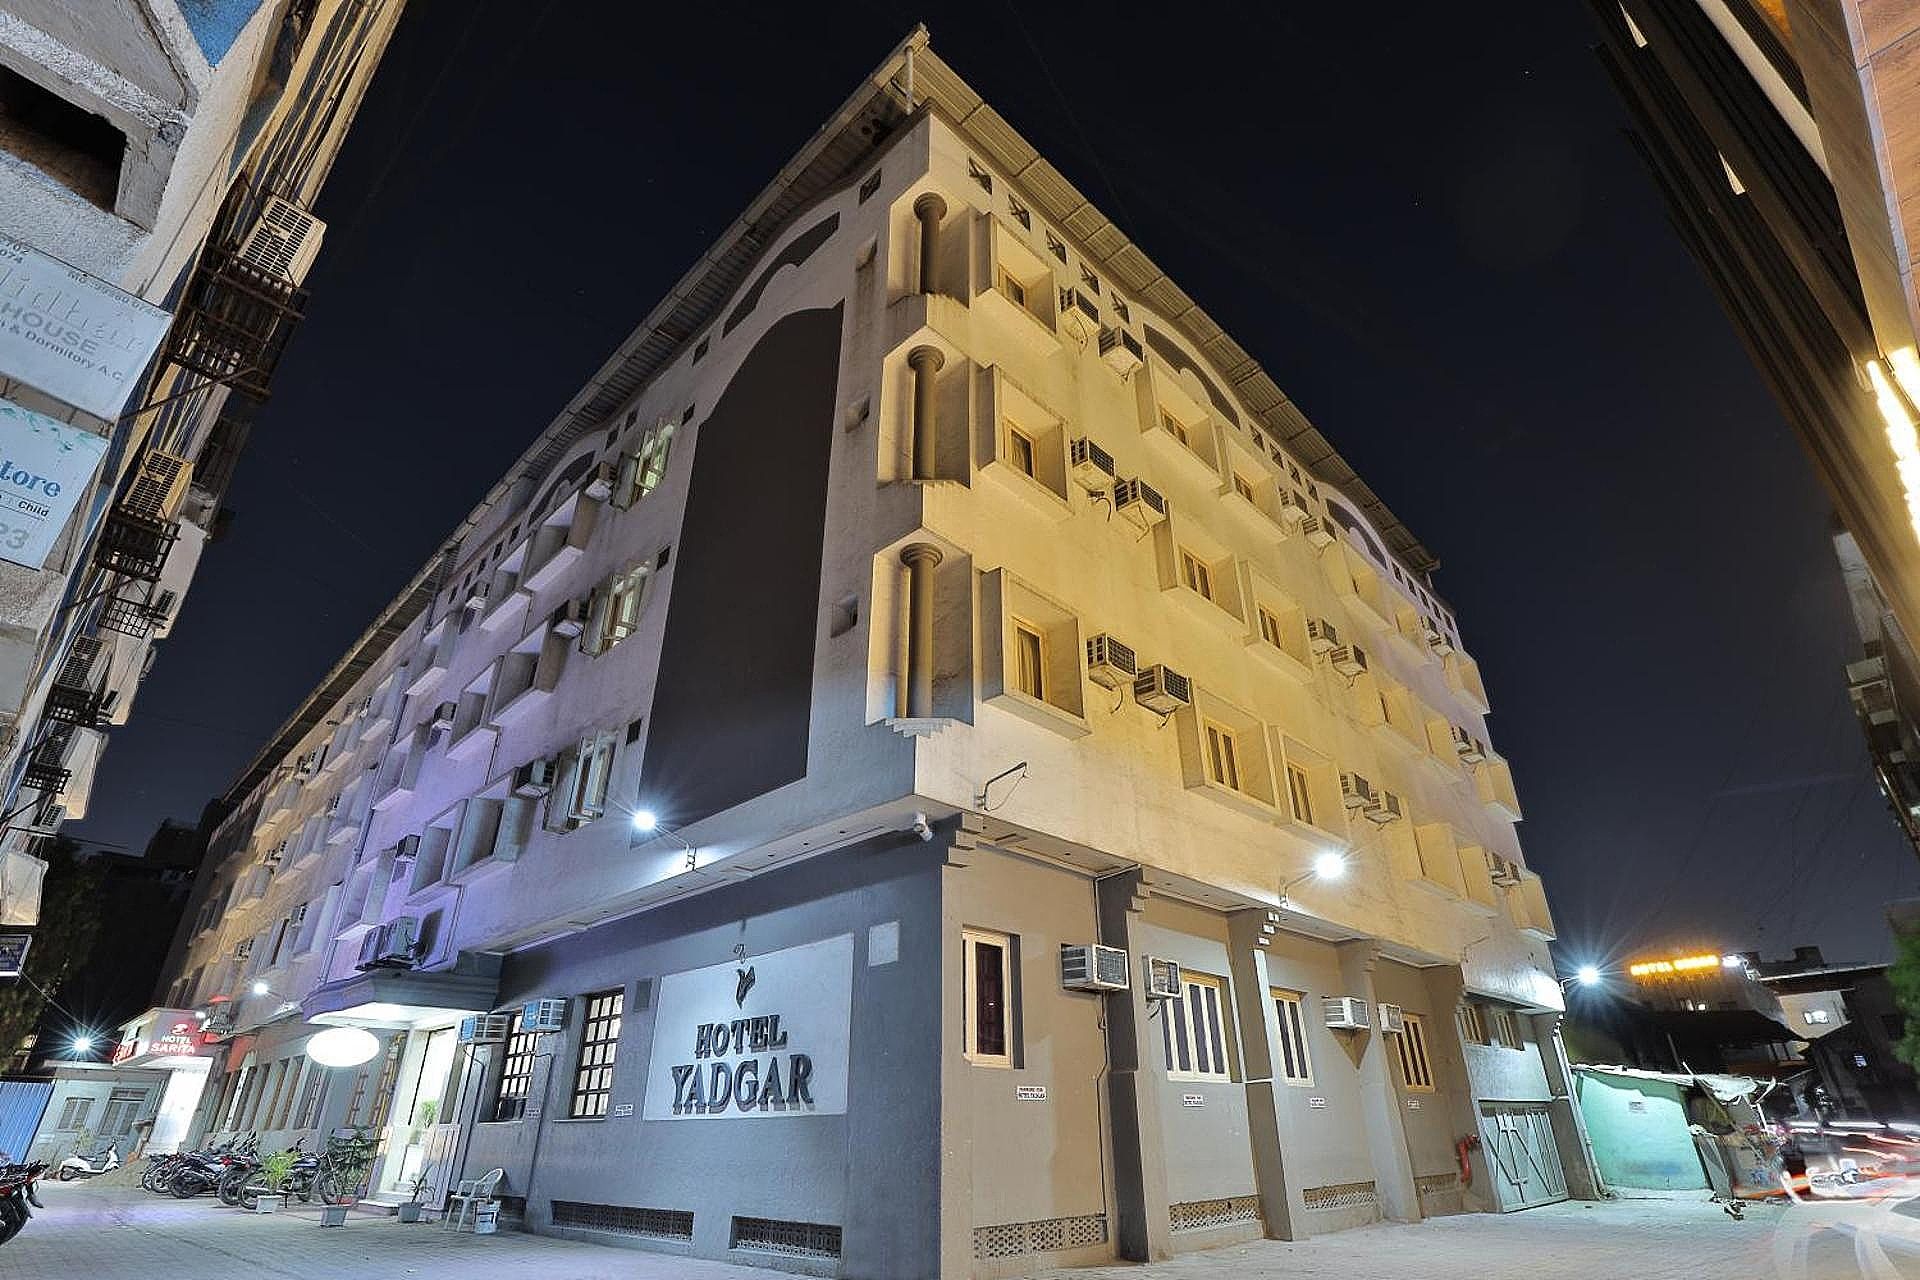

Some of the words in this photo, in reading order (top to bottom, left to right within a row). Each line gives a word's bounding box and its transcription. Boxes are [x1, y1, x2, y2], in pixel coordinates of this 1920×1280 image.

[0, 302, 100, 354] HOUSE
[25, 330, 96, 368] Dormitory
[18, 500, 49, 517] Child
[151, 1043, 195, 1054] SARITA
[161, 1034, 192, 1044] HOTEL
[694, 1014, 788, 1060] HOTEL
[671, 1053, 815, 1116] YADGAR
